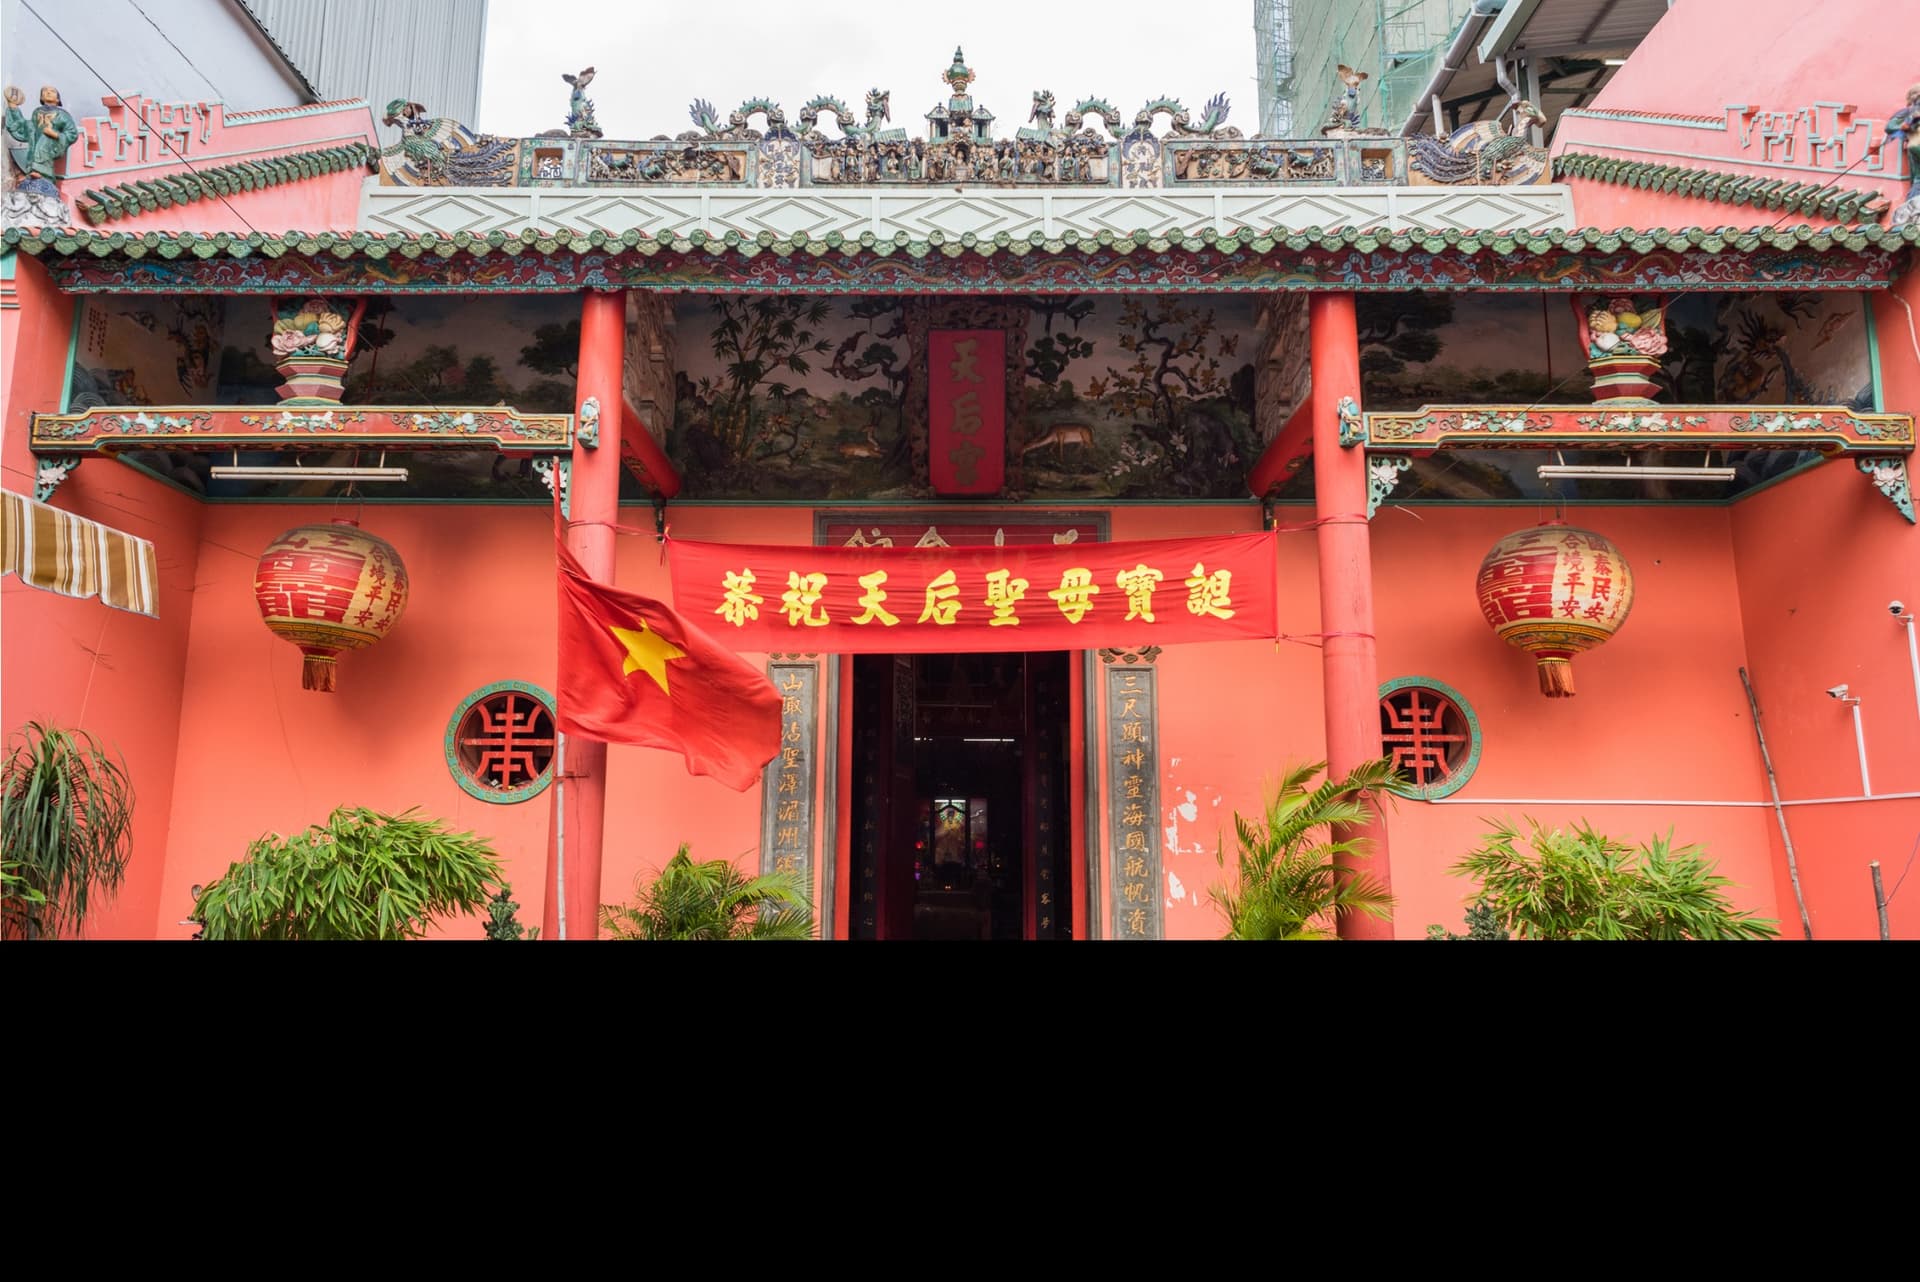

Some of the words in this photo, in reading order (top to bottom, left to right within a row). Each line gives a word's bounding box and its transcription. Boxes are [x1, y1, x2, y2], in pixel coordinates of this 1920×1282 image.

[949, 338, 987, 486] 天后宮
[353, 543, 388, 629] 合境平安
[714, 562, 1236, 627] 恭祝天后聖母寶誕
[1557, 532, 1587, 620] 合境平安
[1582, 534, 1614, 623] 國泰民安
